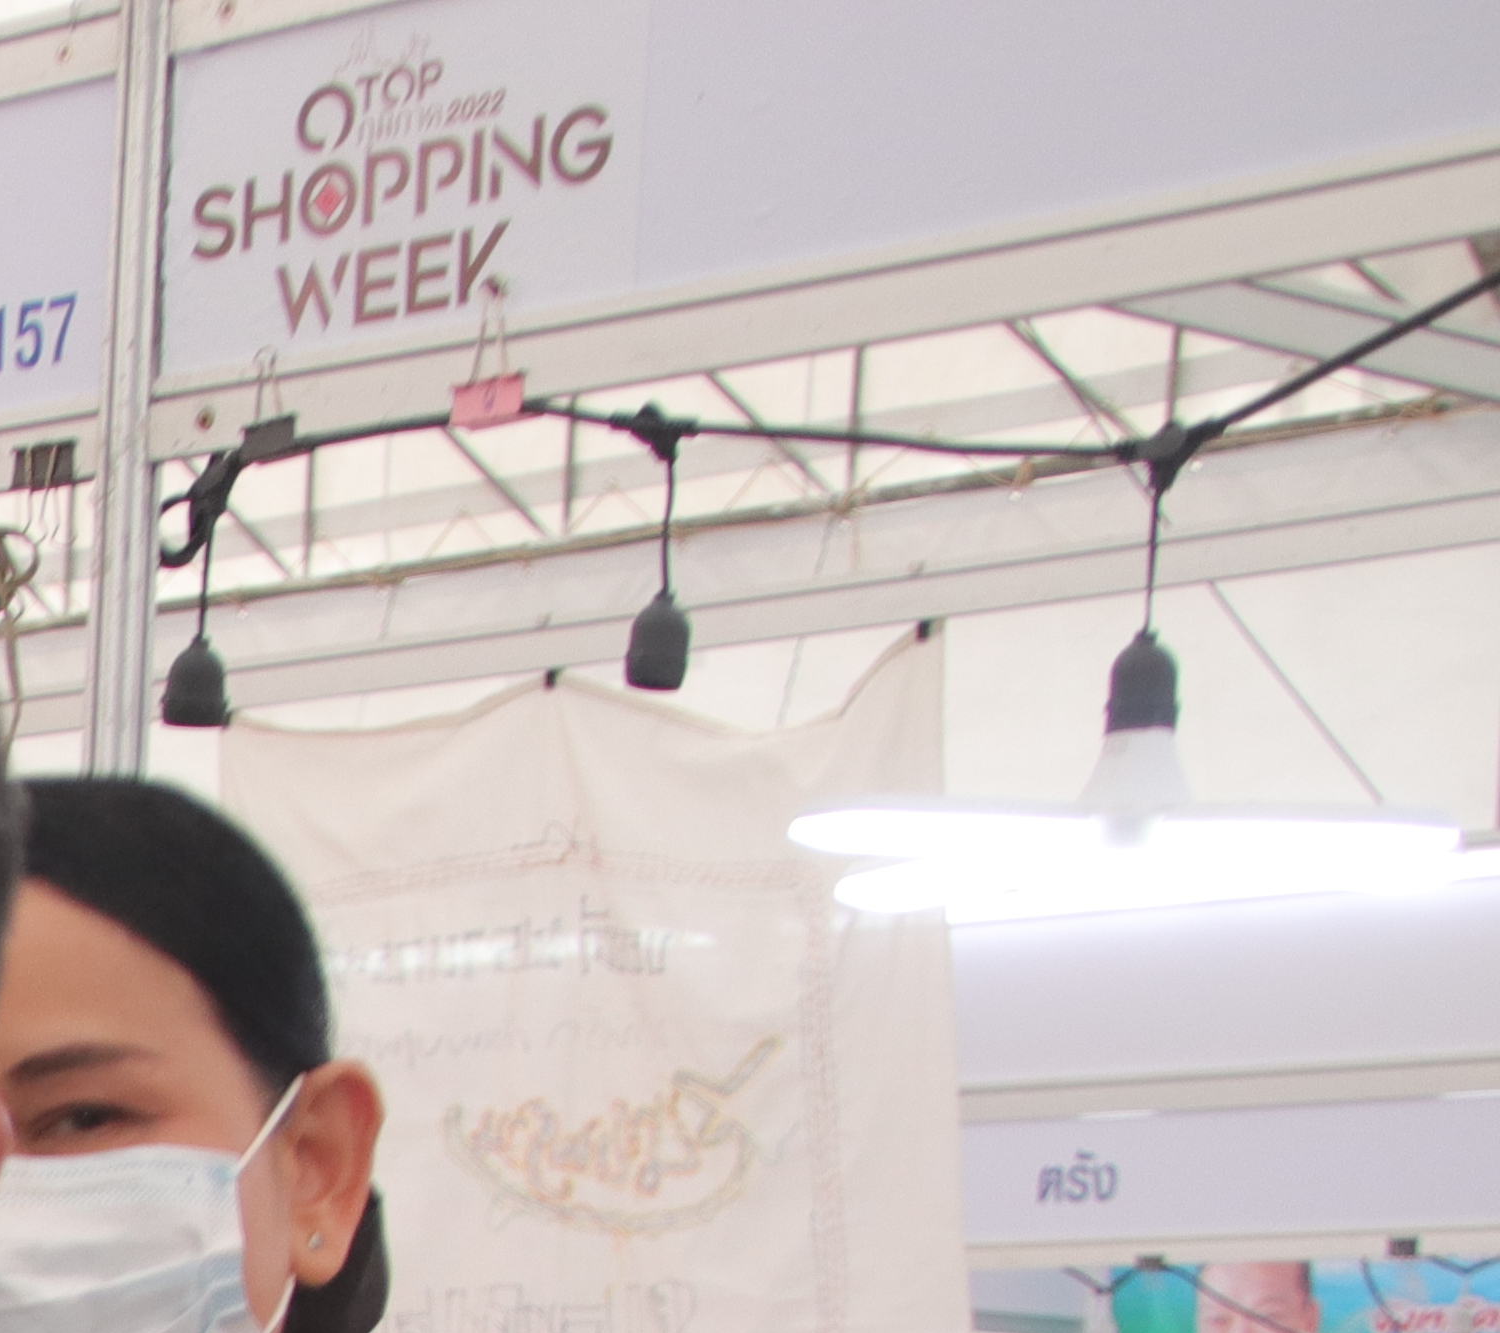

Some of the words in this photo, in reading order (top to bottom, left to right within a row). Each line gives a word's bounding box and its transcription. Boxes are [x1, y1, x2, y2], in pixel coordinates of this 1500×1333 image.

[447, 86, 507, 127] 2022
[191, 104, 614, 260] SHOPPING
[276, 218, 511, 336] WEEK
[1035, 1148, 1119, 1203] ตรัง
